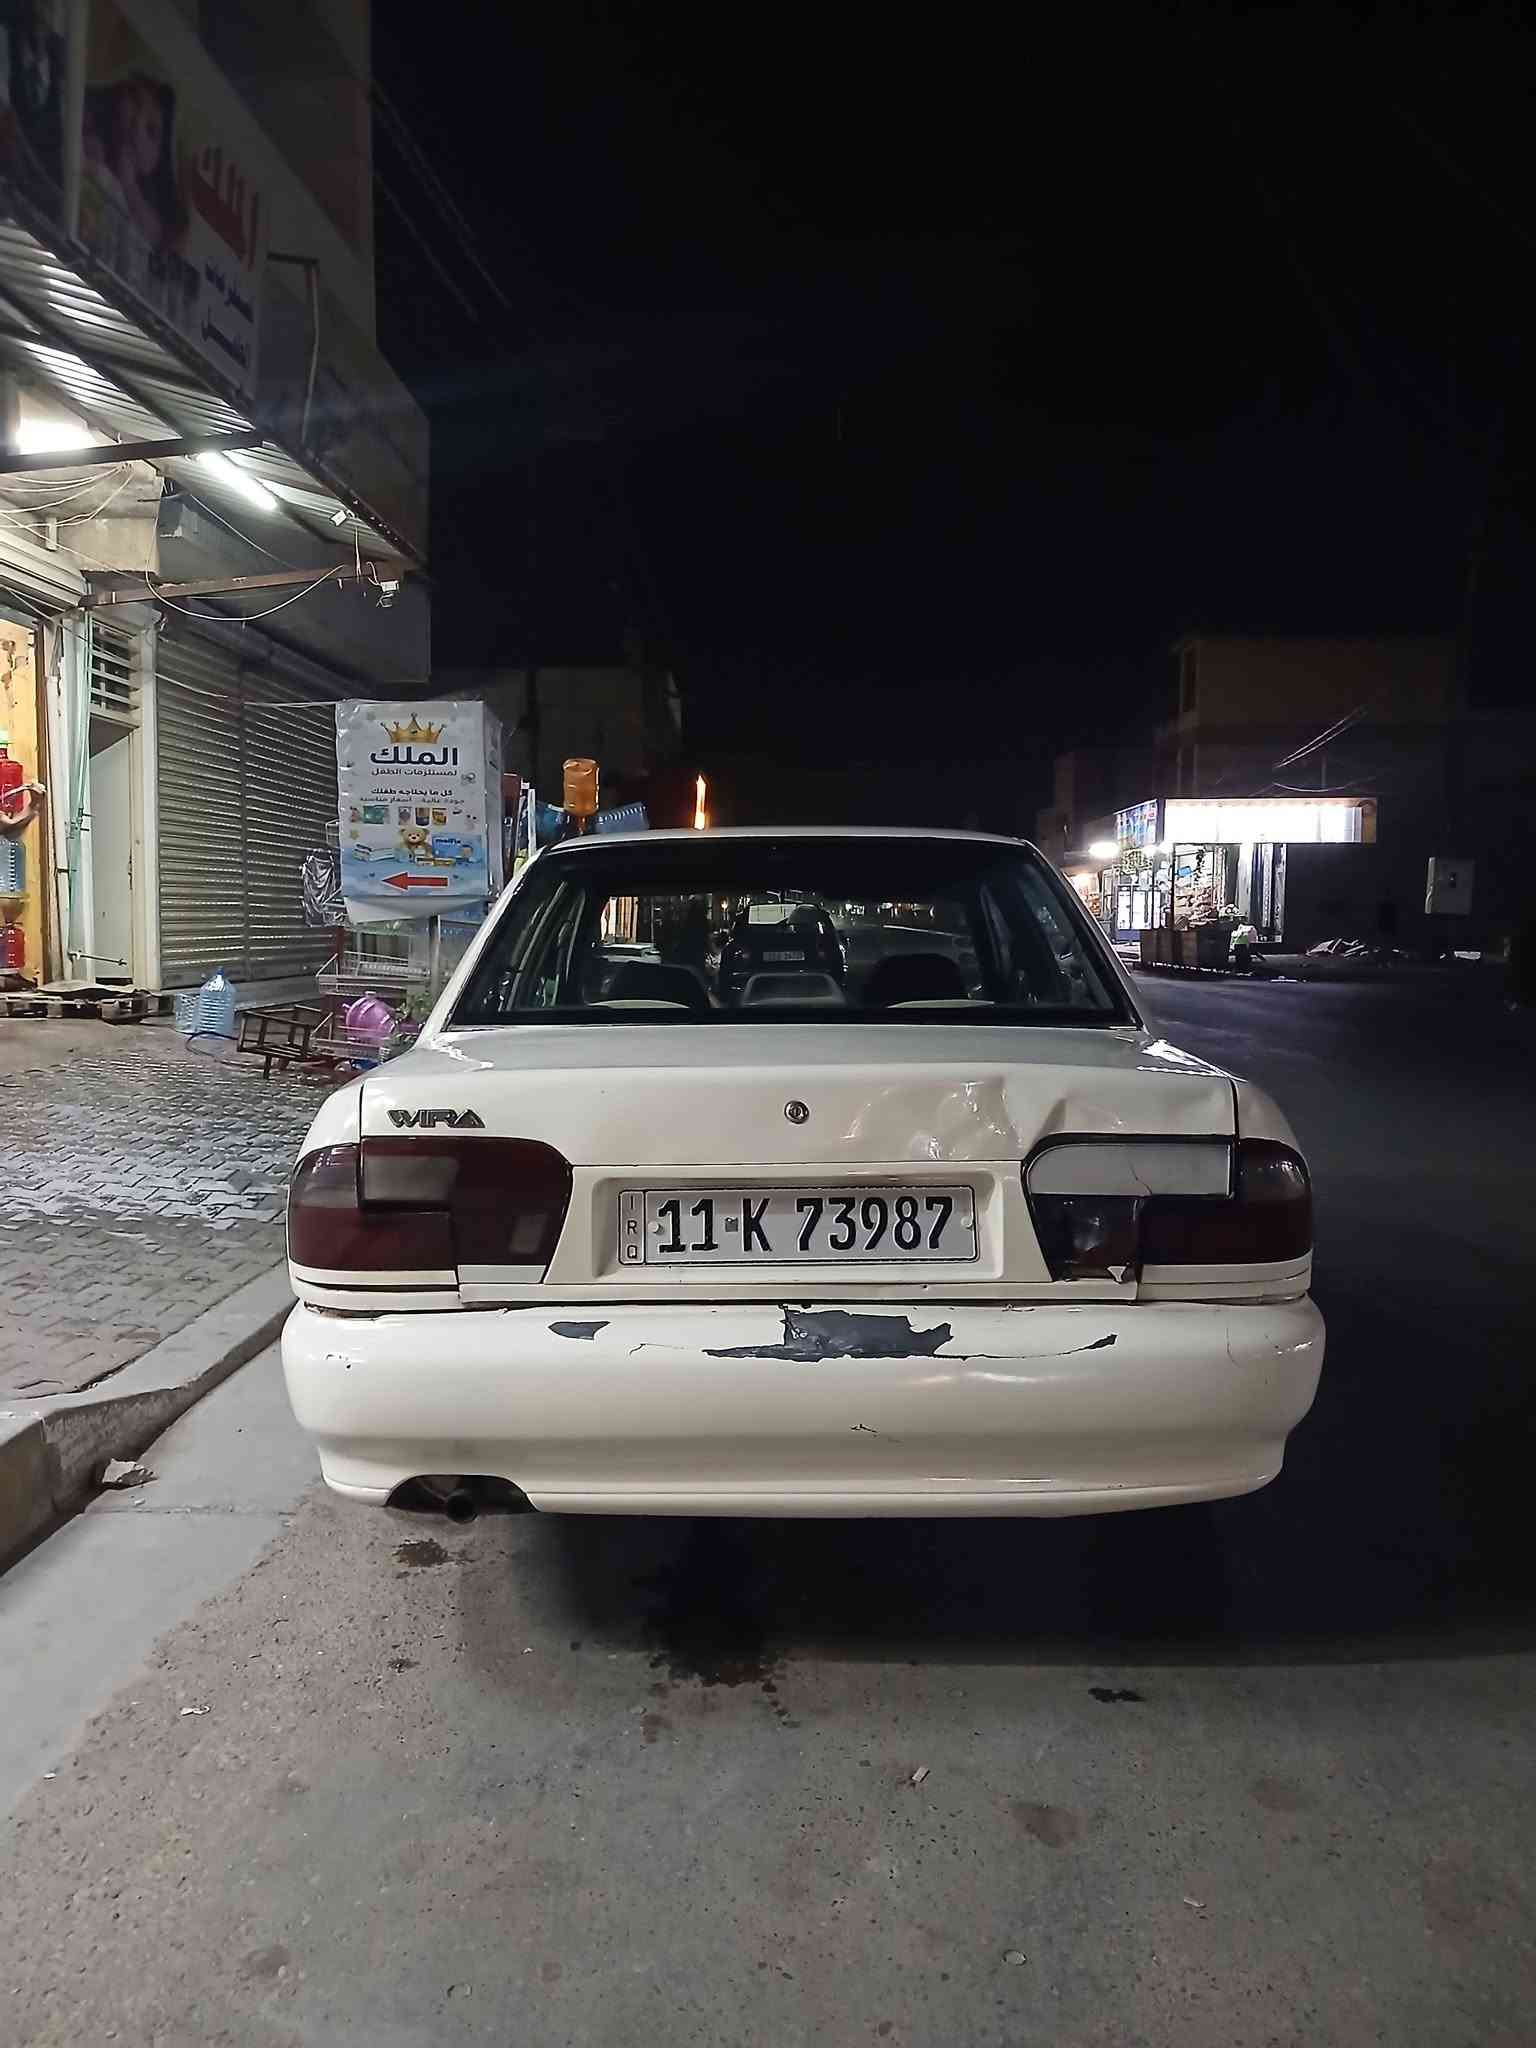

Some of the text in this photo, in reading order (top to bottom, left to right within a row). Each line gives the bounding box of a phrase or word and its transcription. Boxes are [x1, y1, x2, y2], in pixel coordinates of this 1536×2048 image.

[370, 746, 458, 766] الملك
[371, 767, 457, 777] لمستلزمات الطفل
[387, 1109, 486, 1128] WIRA
[658, 1196, 953, 1253] 11 K 73987
